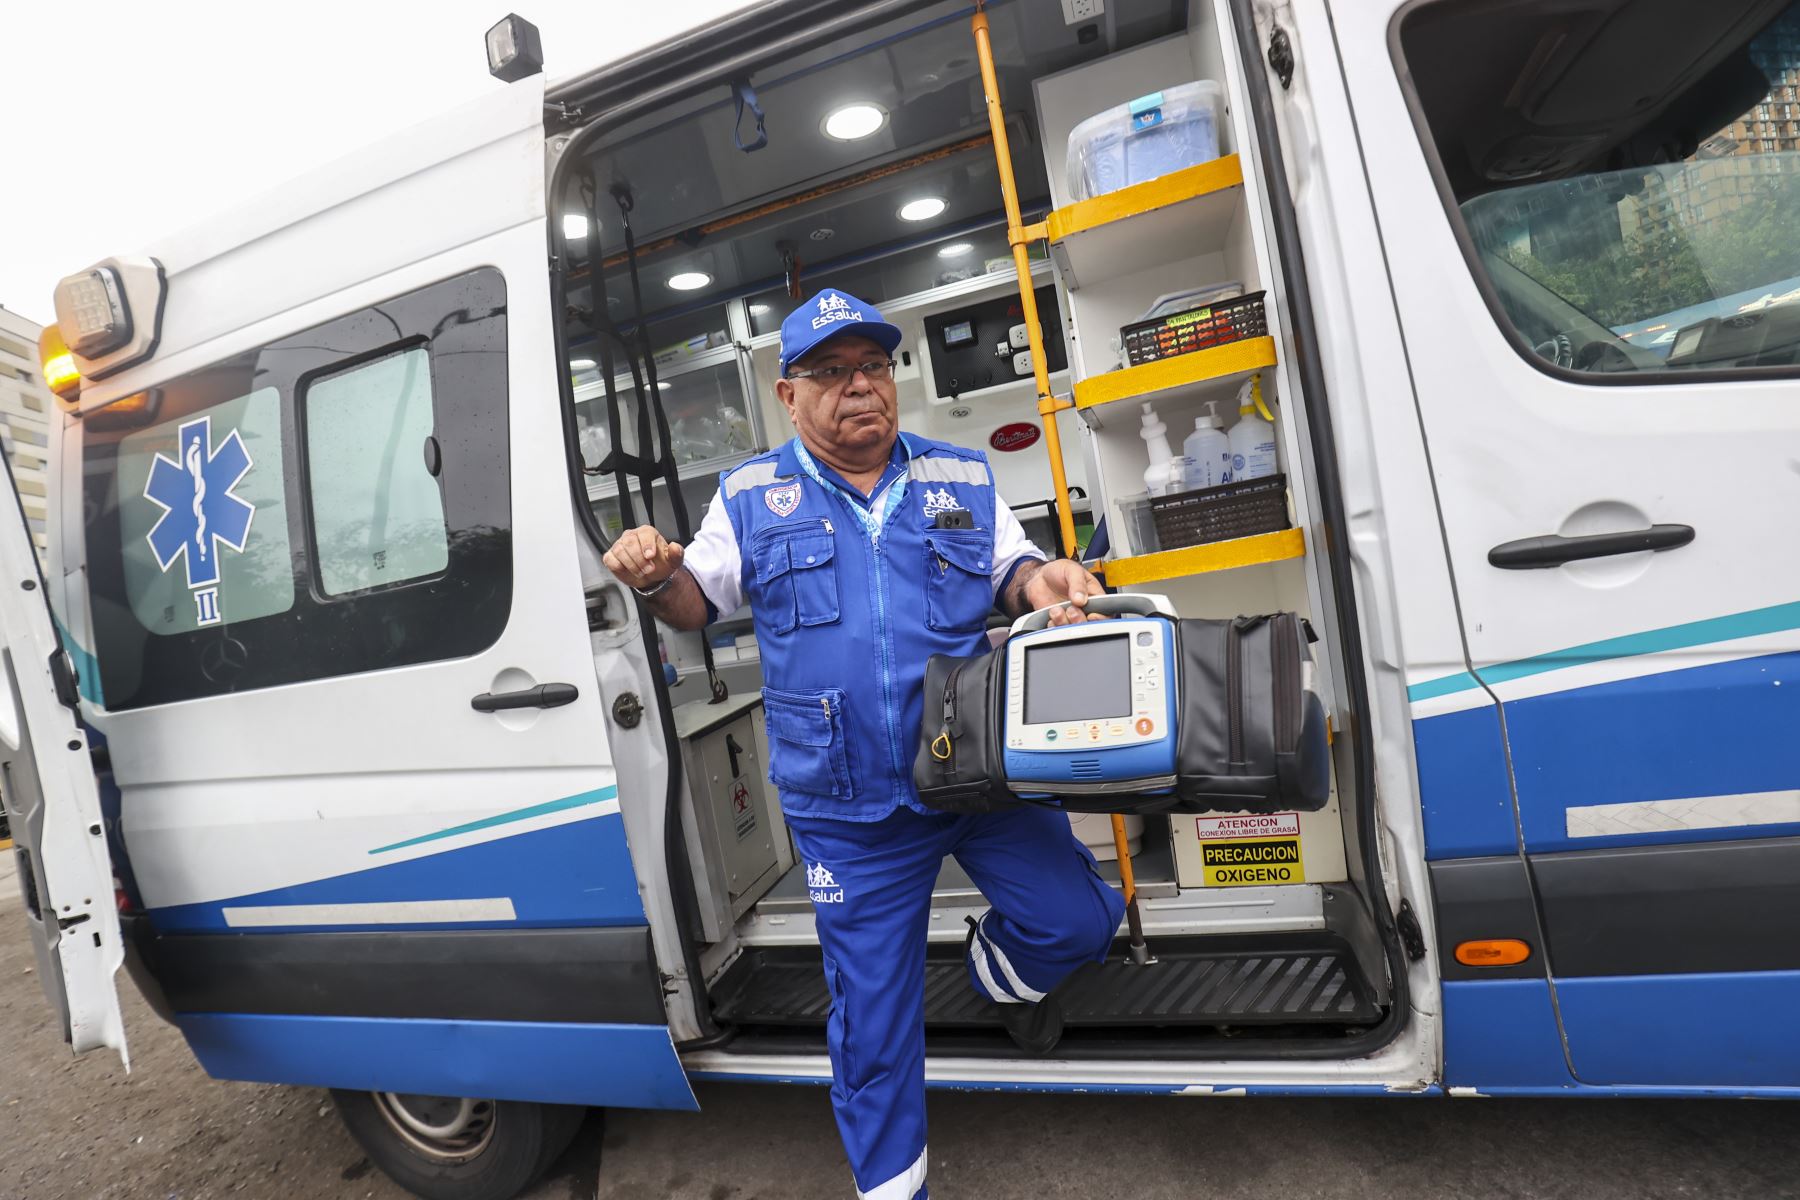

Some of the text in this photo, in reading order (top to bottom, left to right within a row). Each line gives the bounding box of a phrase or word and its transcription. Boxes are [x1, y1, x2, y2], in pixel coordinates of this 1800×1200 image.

[811, 308, 863, 330] EsSalud
[1217, 817, 1278, 829] ATENCION
[1200, 829, 1236, 837] CONEXION
[1238, 828, 1259, 836] LIBRE
[1271, 826, 1297, 834] GRASA
[1205, 845, 1297, 863] PRECAUCION
[1215, 867, 1291, 883] OXIGENO
